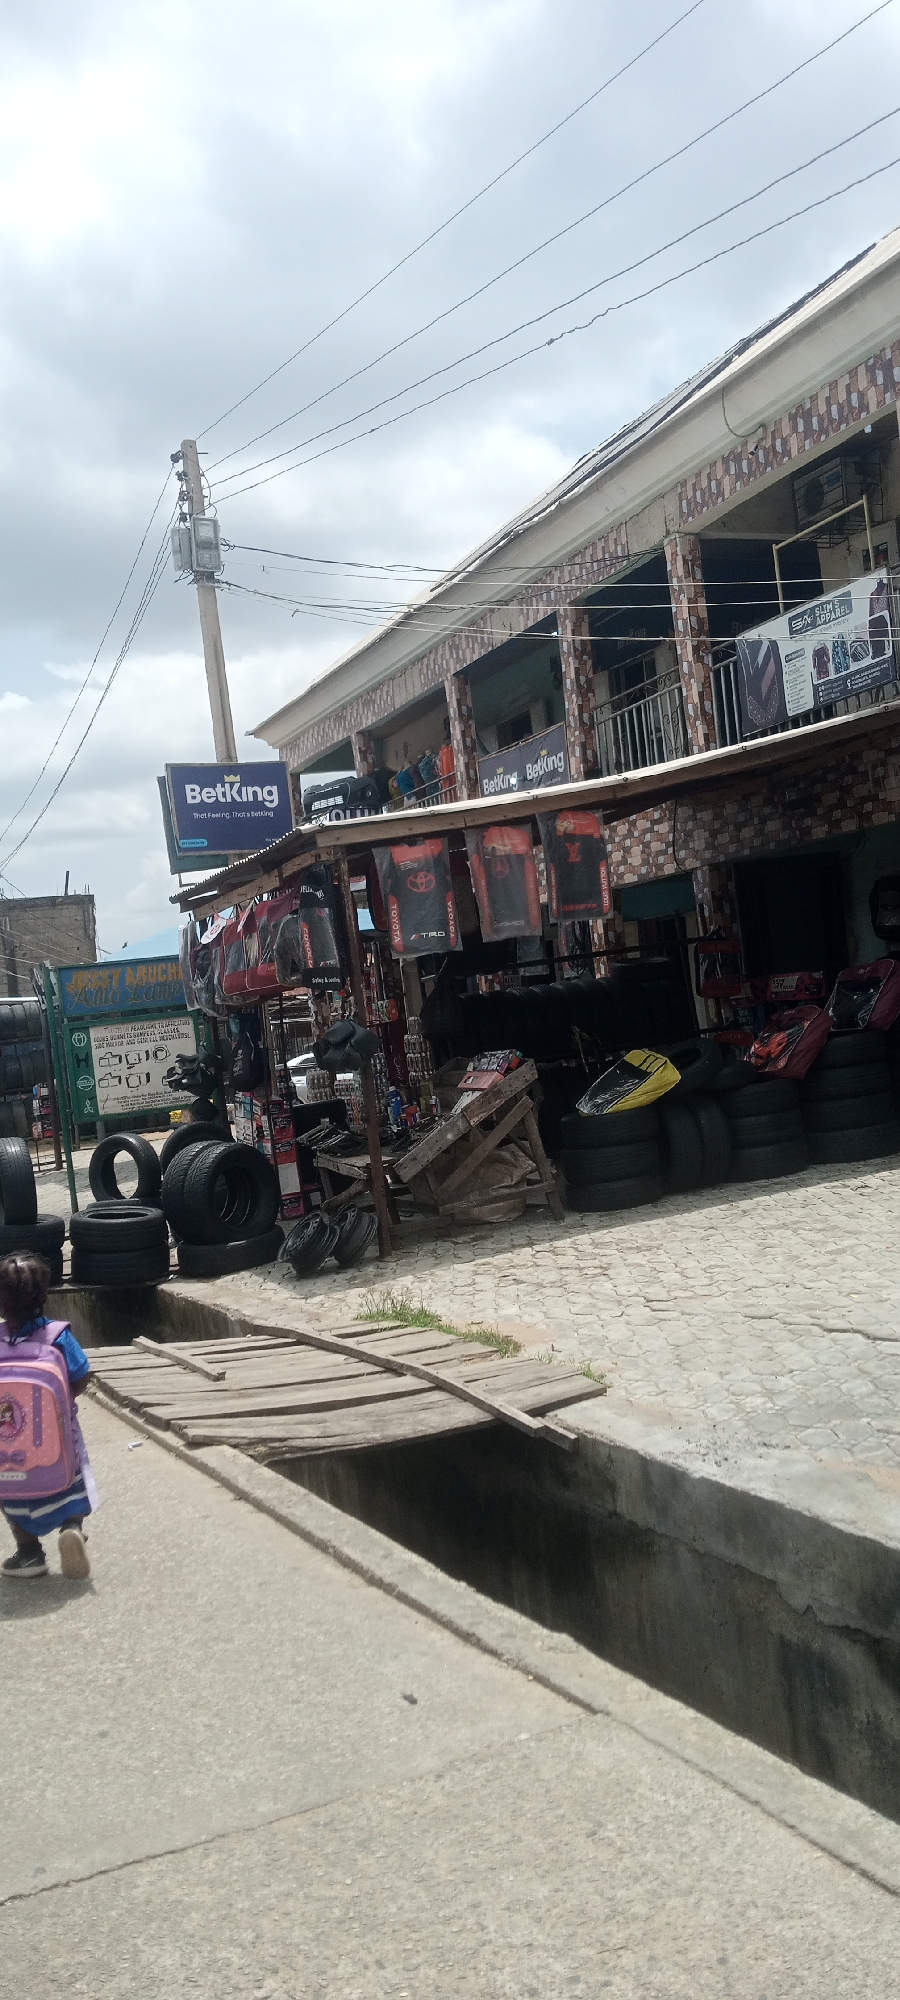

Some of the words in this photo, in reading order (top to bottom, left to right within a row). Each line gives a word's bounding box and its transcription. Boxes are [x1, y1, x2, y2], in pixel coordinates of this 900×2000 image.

[816, 605, 850, 626] APPAREL
[526, 751, 564, 780] BetKing
[185, 783, 279, 808] BetKing
[483, 771, 518, 796] BetKing
[390, 904, 400, 943] TOYOTA
[447, 901, 455, 938] TOYOTA
[421, 931, 446, 939] TRD
[66, 968, 122, 995] JOSSY
[68, 985, 121, 1009] Auto
